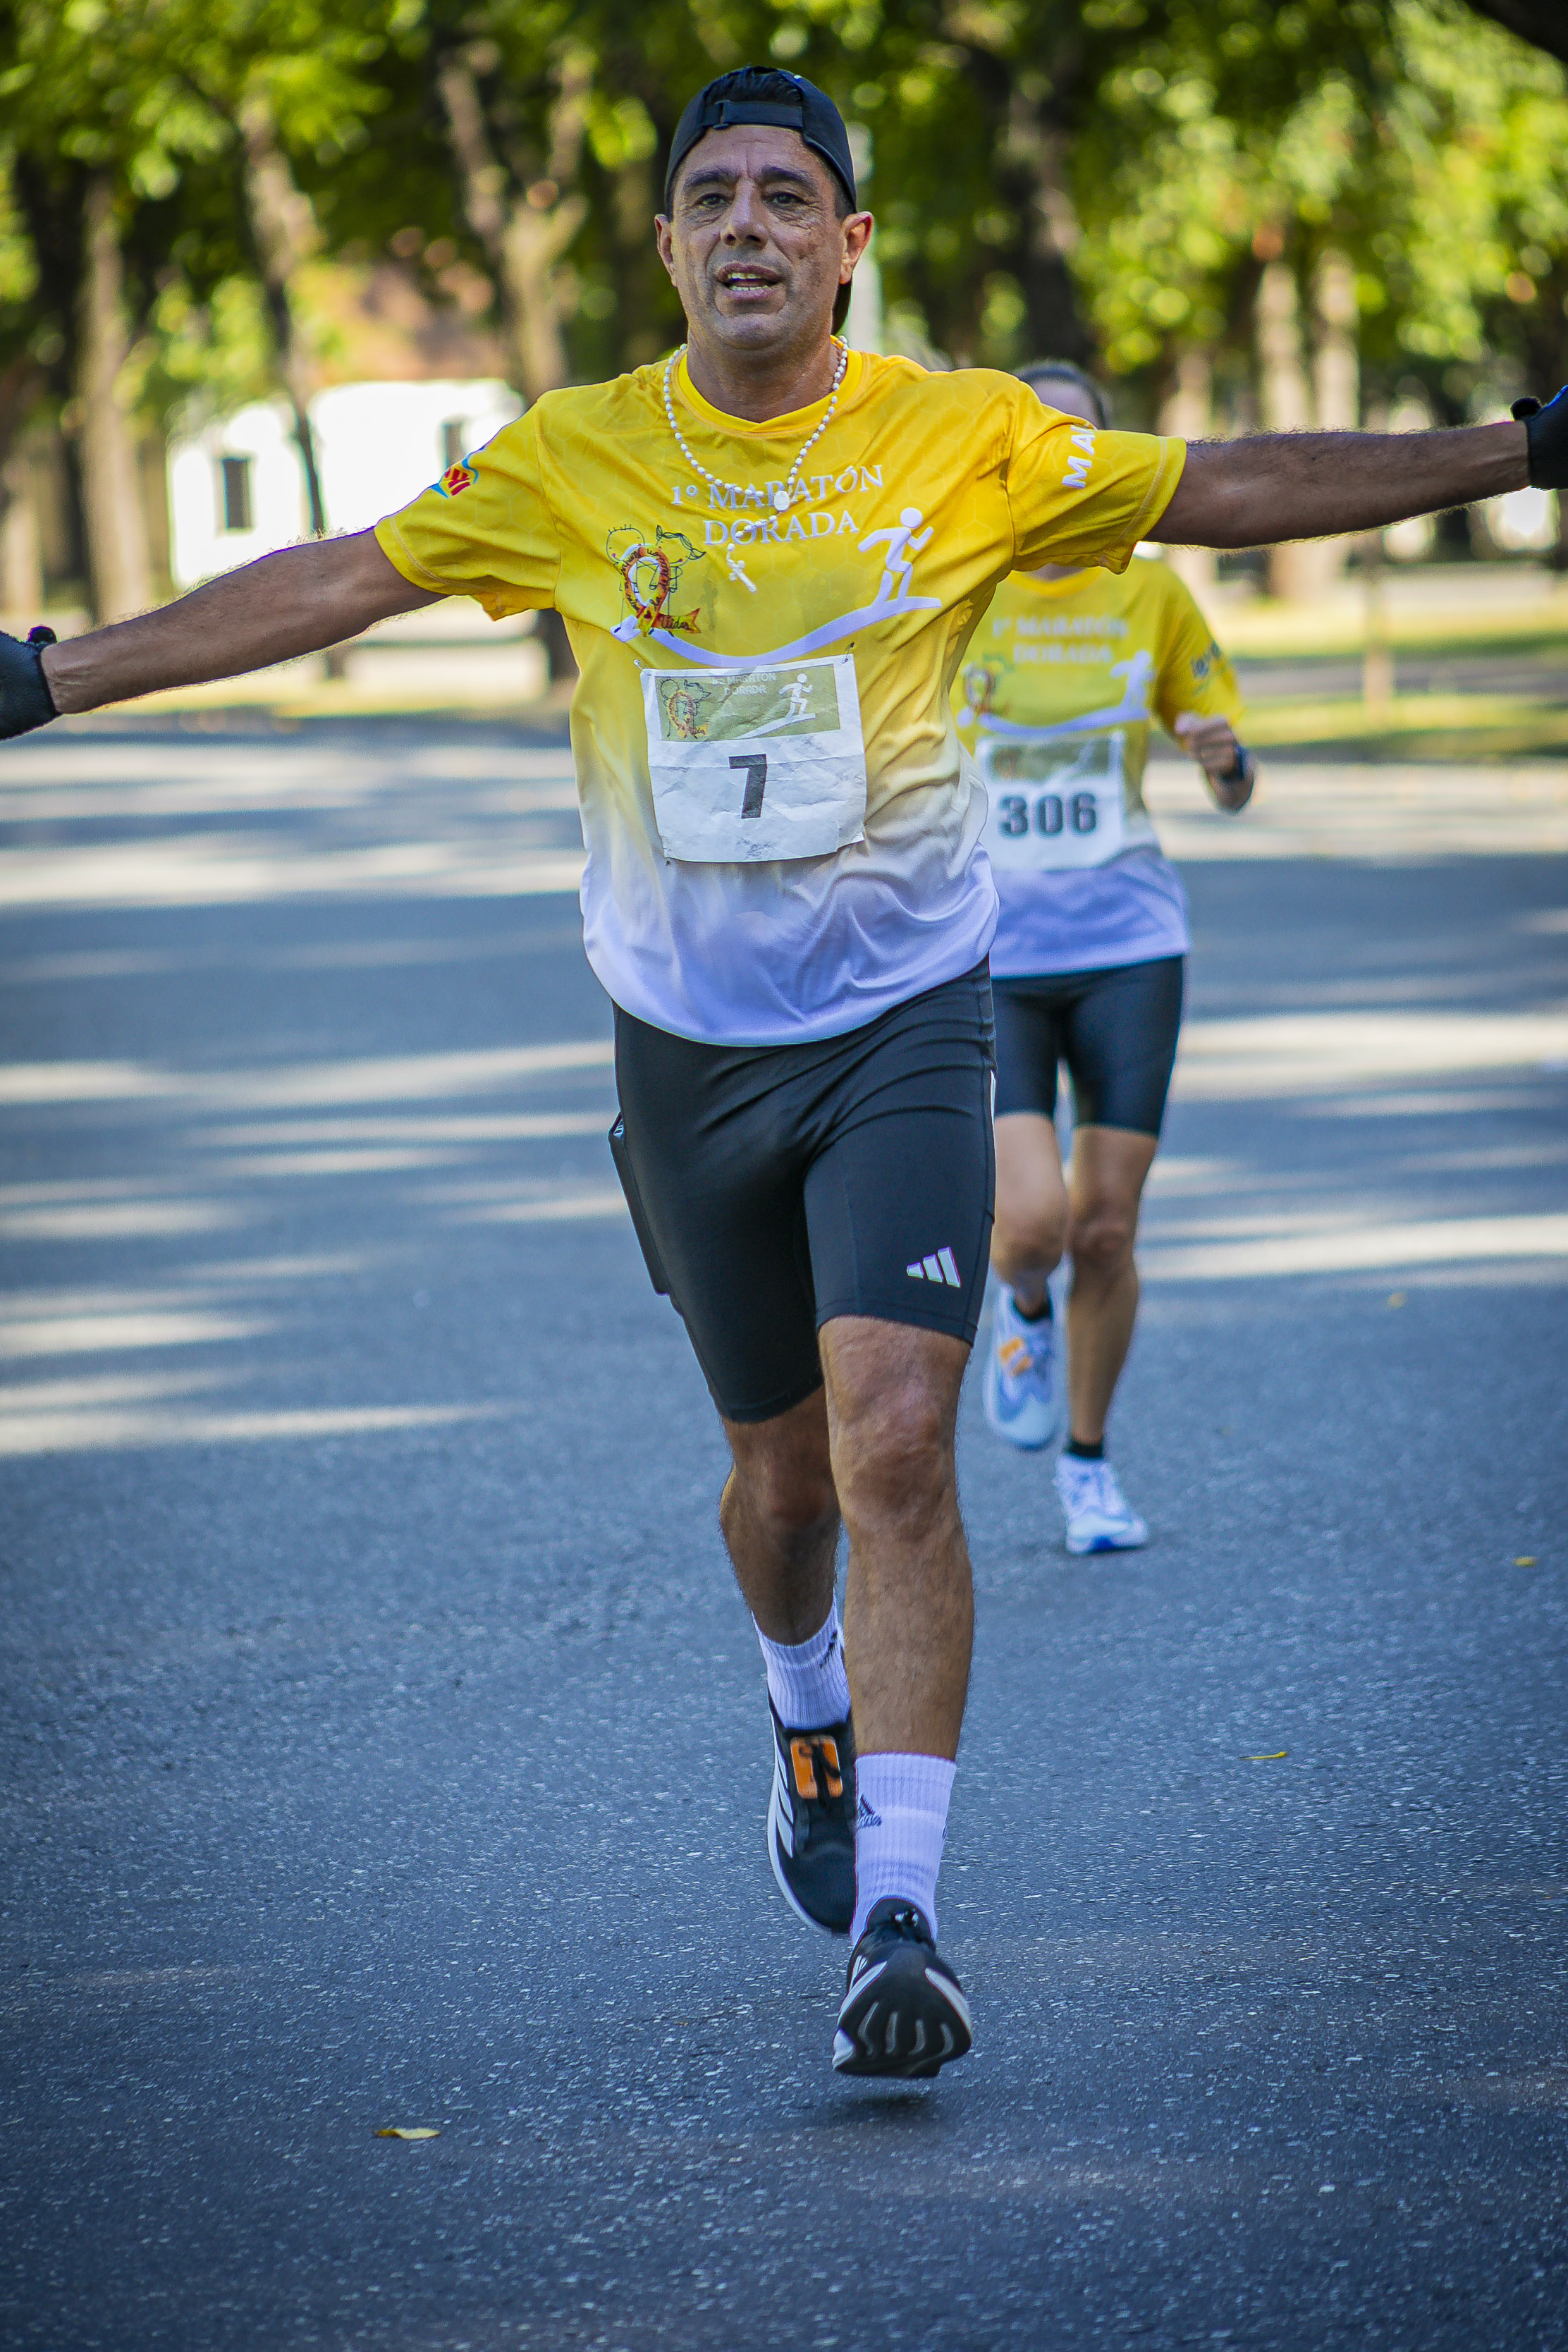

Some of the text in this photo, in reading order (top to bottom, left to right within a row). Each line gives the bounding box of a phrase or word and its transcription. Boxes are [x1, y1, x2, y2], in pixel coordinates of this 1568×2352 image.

[708, 465, 883, 509] MARATÓN
[704, 510, 859, 544] DORADA
[728, 754, 767, 819] 7
[999, 793, 1098, 838] 306
